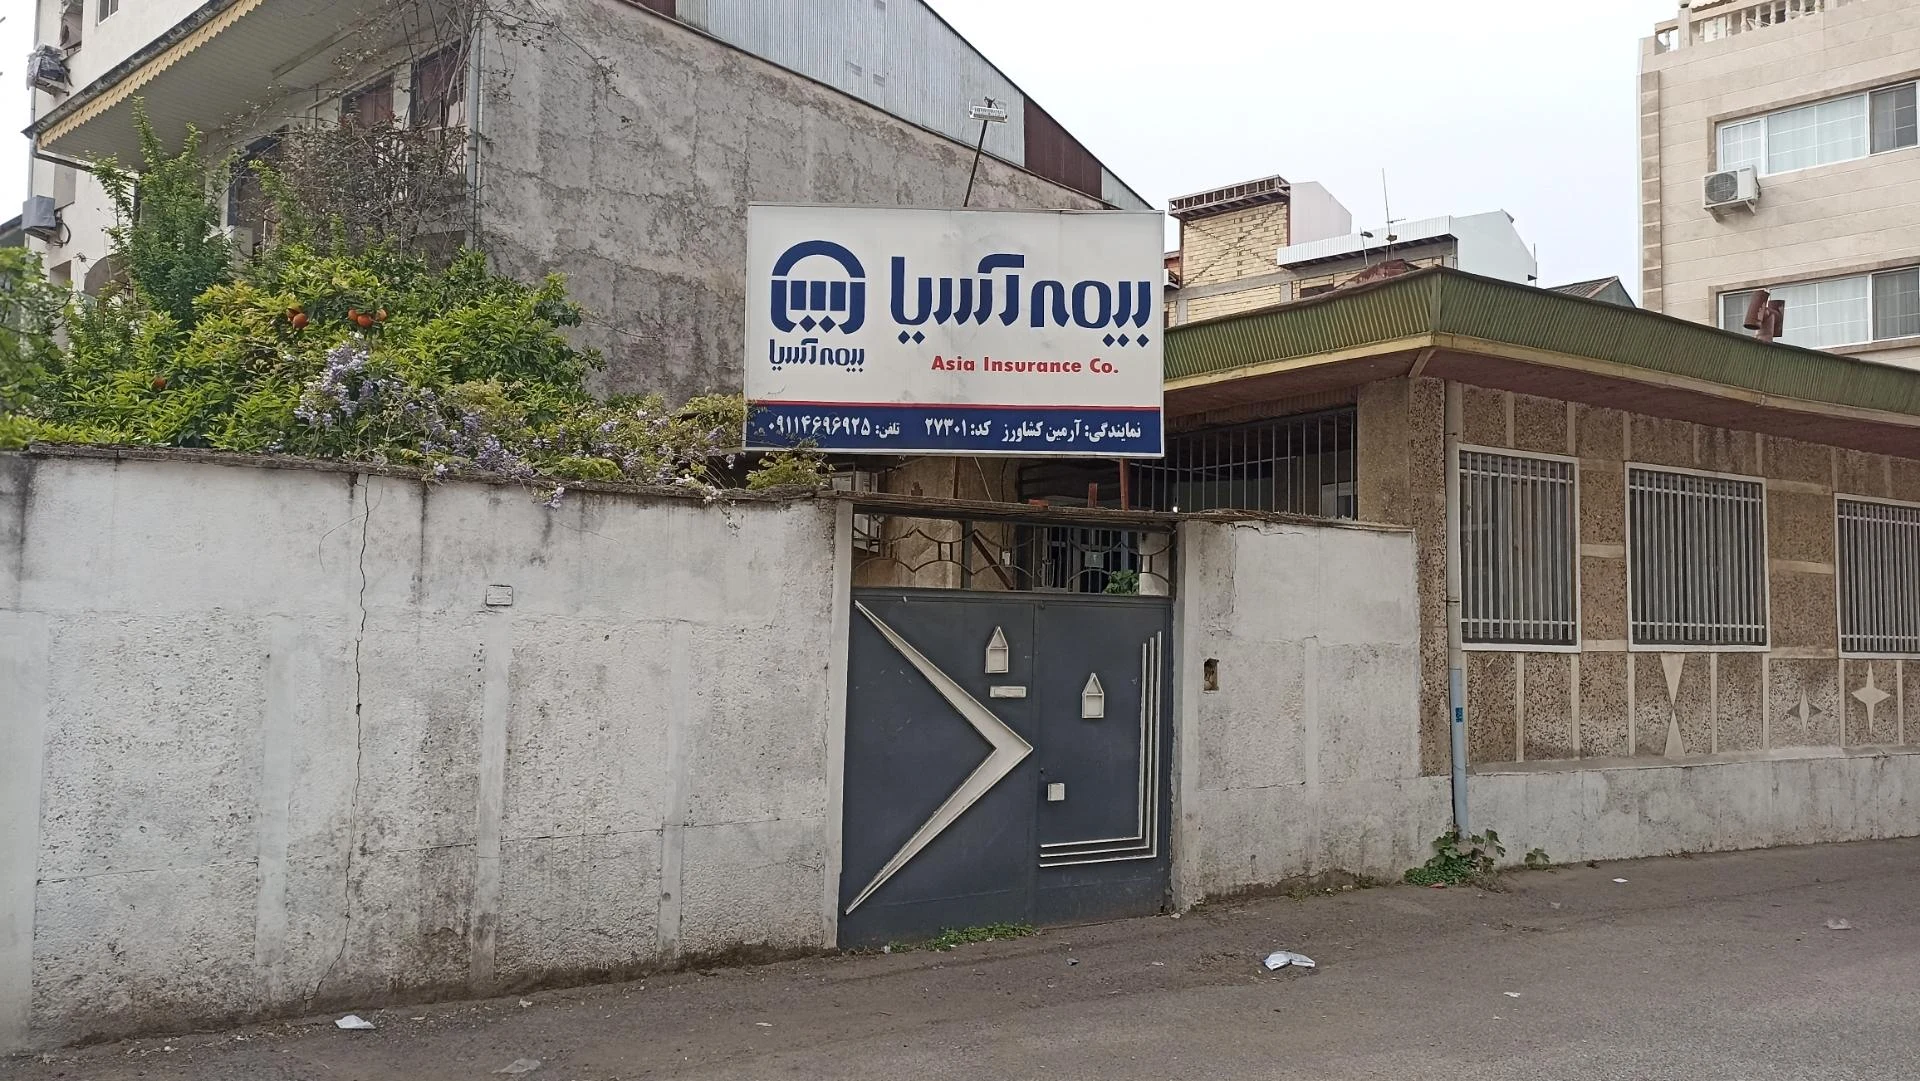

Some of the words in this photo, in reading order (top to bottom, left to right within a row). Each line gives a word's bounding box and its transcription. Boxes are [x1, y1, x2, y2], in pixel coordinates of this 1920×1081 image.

[890, 253, 1025, 345] آسیا
[1031, 279, 1152, 348] بیمه
[768, 337, 819, 372] آسیا
[819, 346, 866, 373] بیمه
[931, 355, 976, 372] Asia
[983, 356, 1083, 374] Insurance
[1088, 357, 1120, 375] Co.
[875, 421, 901, 439] تلفن:
[924, 417, 968, 437] ۲۷۳۰۱
[970, 420, 993, 436] کد:
[1001, 420, 1045, 442] کشاورز
[1045, 419, 1082, 443] آرمین
[1084, 421, 1142, 443] نمایندگی:
